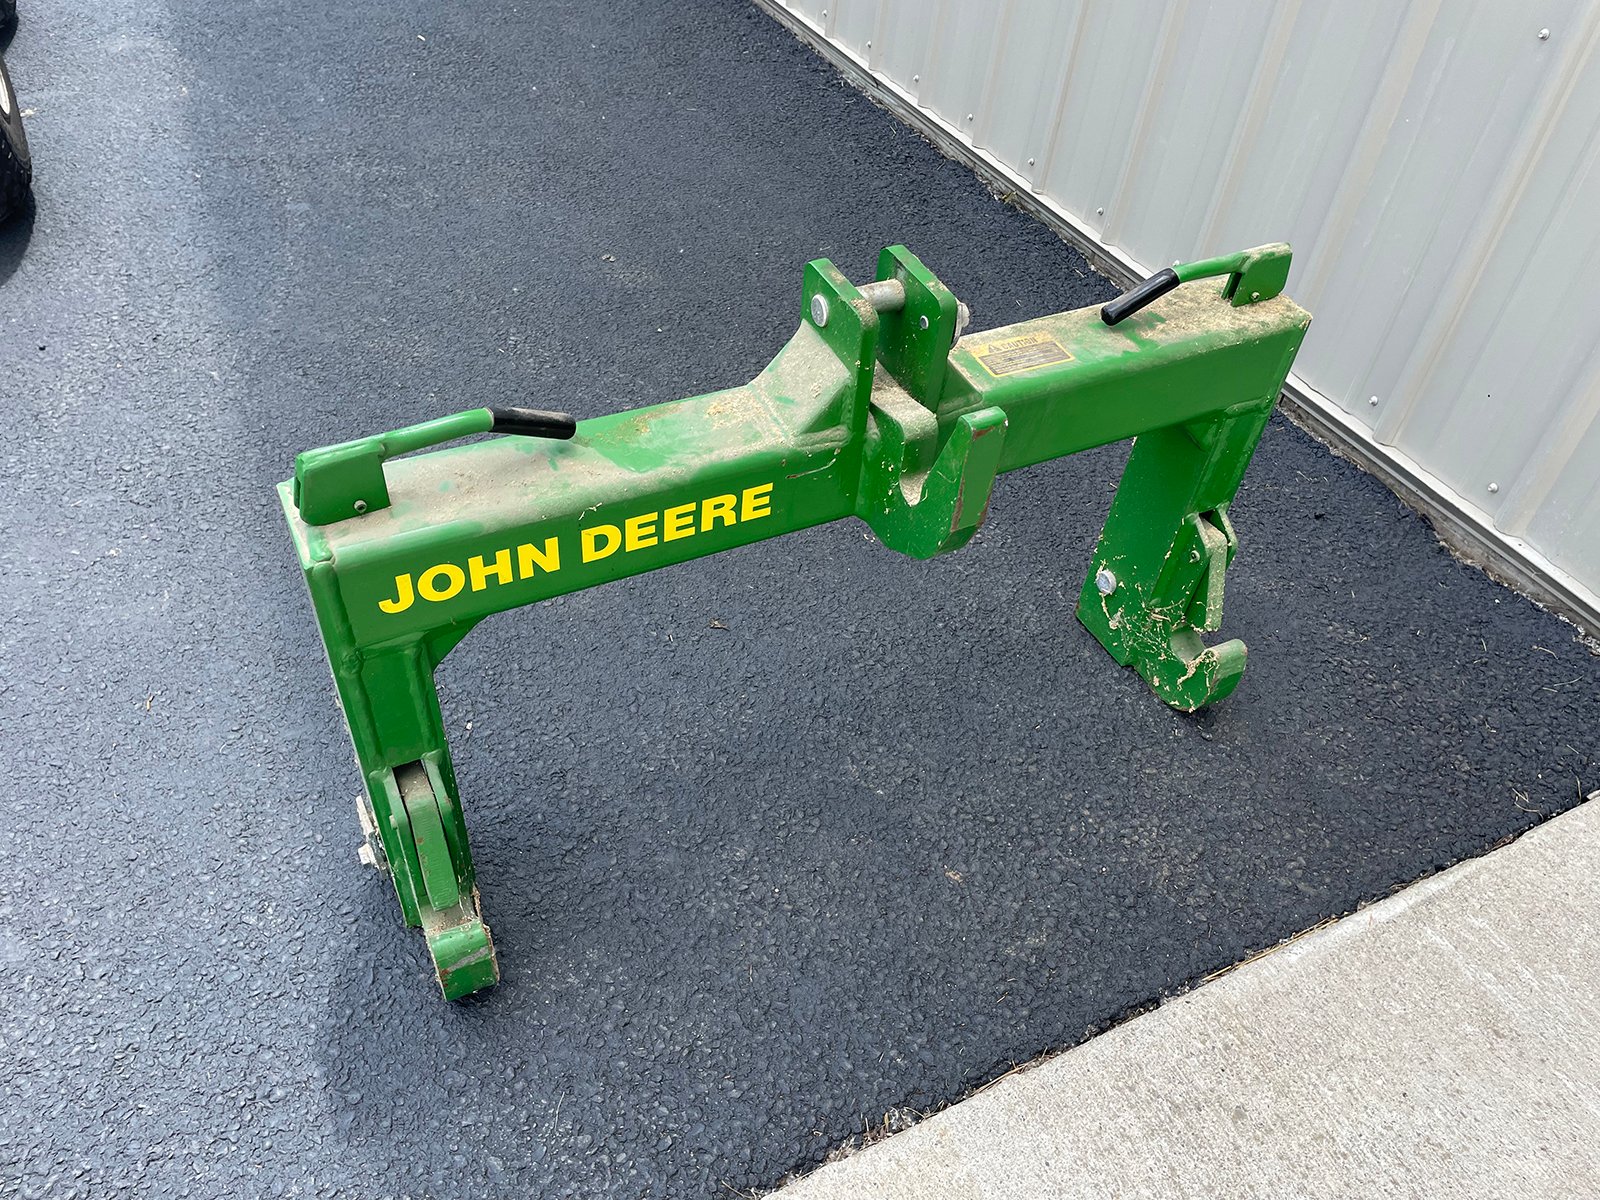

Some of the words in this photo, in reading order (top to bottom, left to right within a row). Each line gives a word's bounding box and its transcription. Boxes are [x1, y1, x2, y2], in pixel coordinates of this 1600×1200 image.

[1001, 337, 1038, 350] CAUTION
[378, 537, 561, 614] JOHN
[581, 483, 774, 563] DEERE
